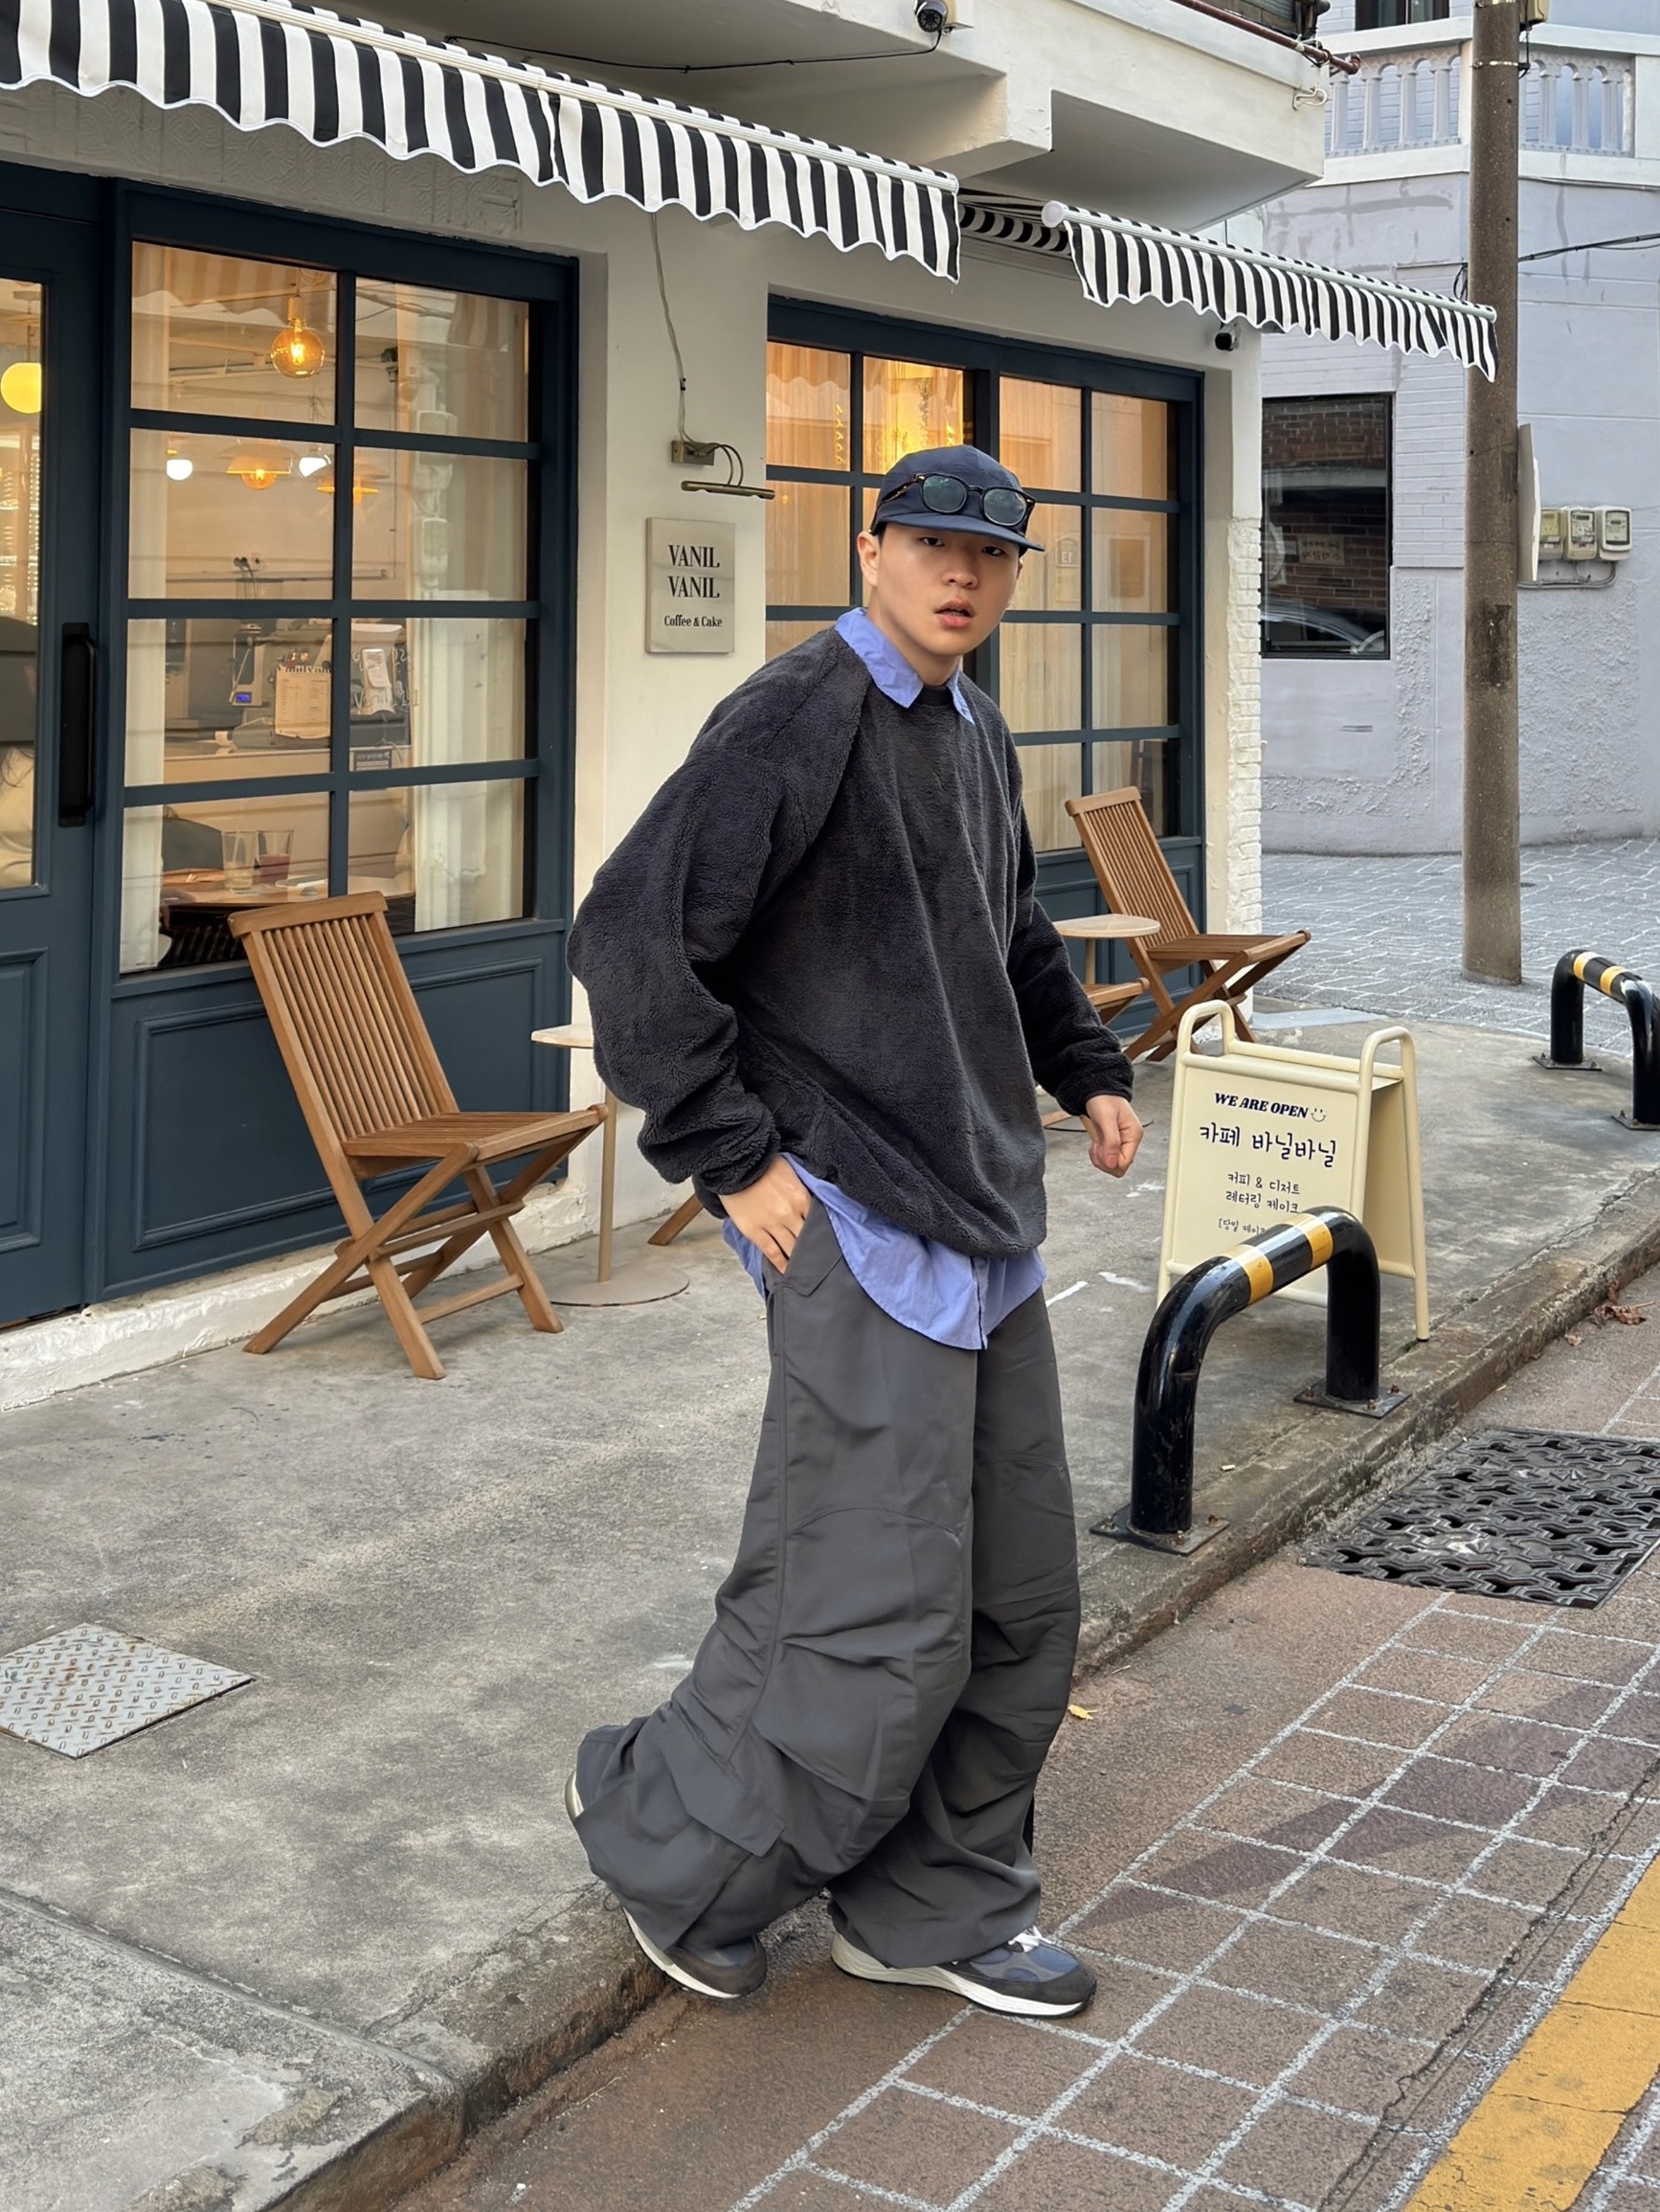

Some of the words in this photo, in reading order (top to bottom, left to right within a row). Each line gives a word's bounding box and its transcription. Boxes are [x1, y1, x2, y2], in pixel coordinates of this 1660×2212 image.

[668, 545, 720, 568] VANIL
[668, 576, 720, 598] VANIL
[664, 614, 691, 627] Coffee
[693, 617, 700, 627] &
[701, 616, 723, 627] Cake
[1215, 1093, 1238, 1107] WE
[1239, 1097, 1268, 1112] ARE
[1270, 1102, 1309, 1118] OPEN
[1200, 1121, 1241, 1147] 카페
[1252, 1131, 1335, 1167] 바닐바닐
[1227, 1171, 1250, 1186] 커피
[1255, 1176, 1263, 1188] &
[1269, 1179, 1300, 1195] 디저트
[1225, 1190, 1262, 1208] 레터링
[1267, 1198, 1299, 1213] 케이크
